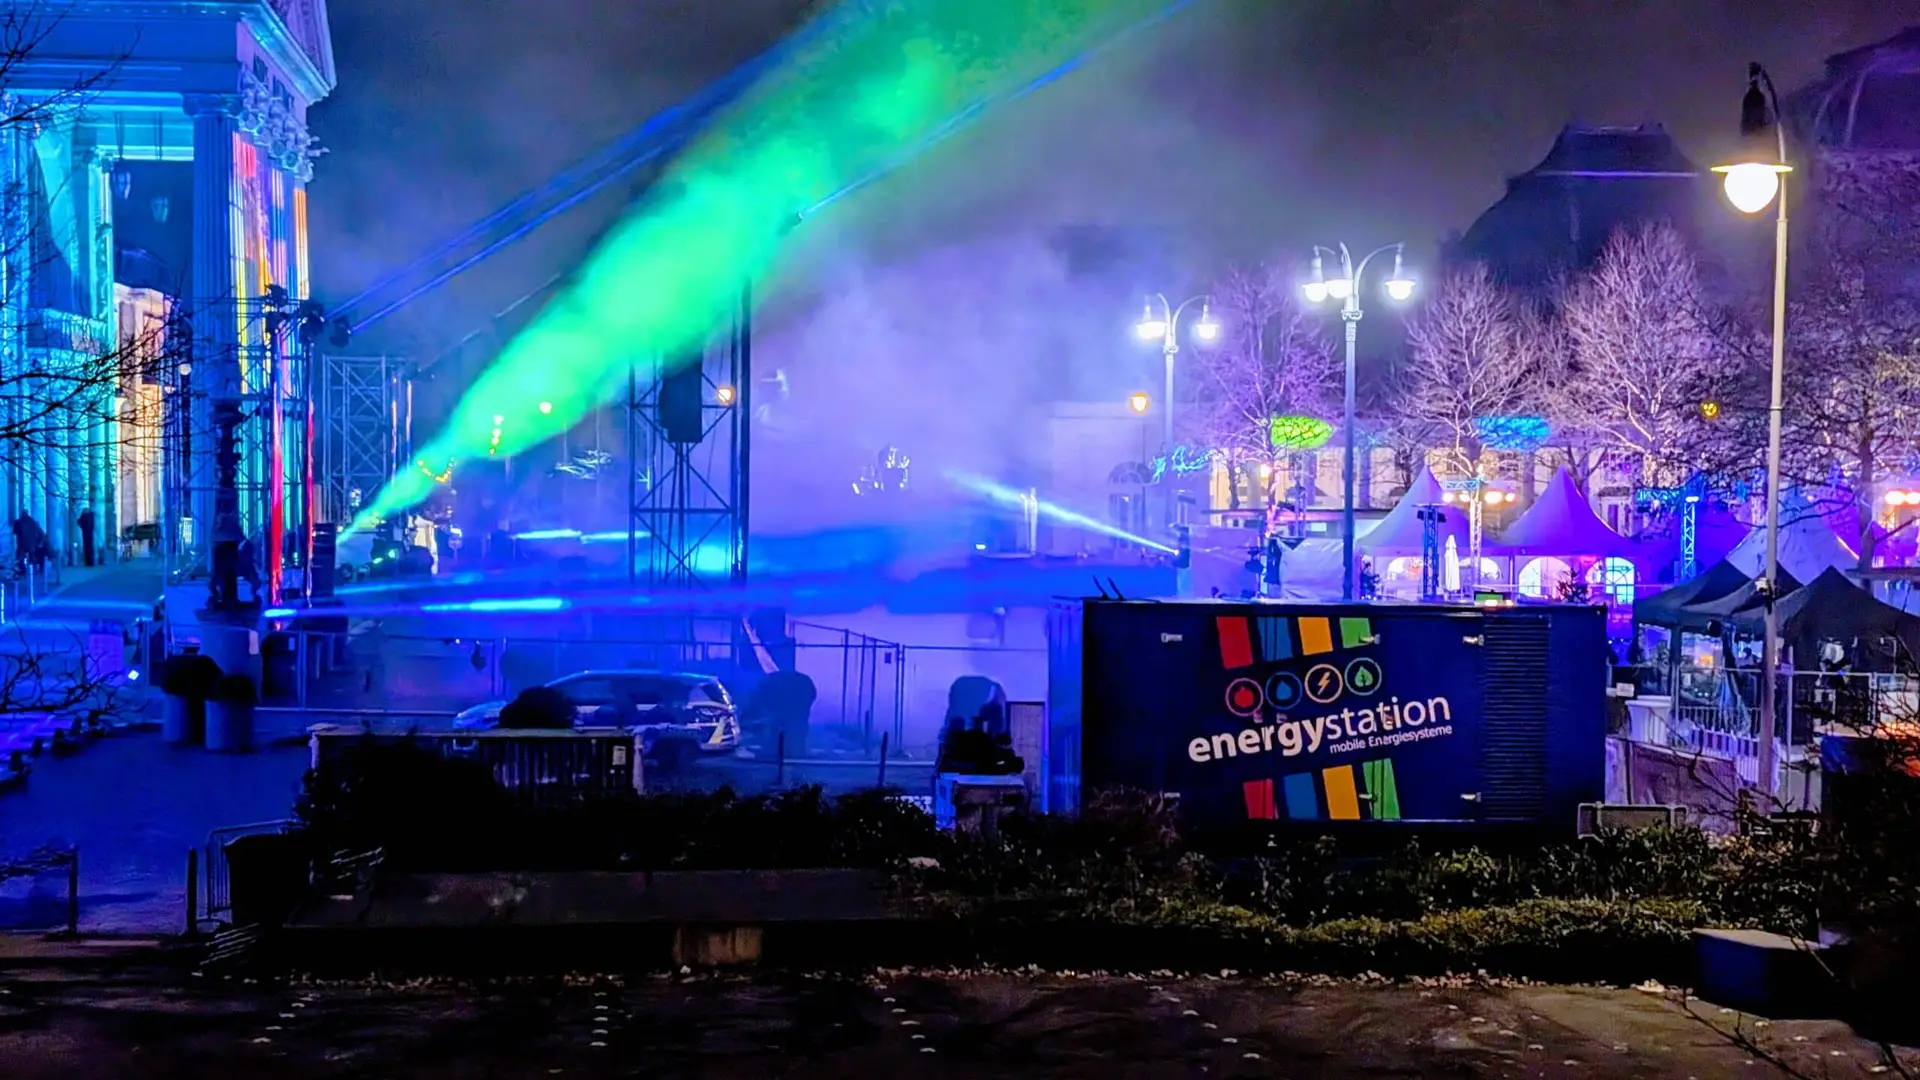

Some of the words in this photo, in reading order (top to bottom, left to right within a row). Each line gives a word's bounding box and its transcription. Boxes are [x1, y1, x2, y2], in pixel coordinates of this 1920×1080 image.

[1188, 696, 1451, 762] energystation
[1329, 739, 1366, 754] mobile
[1368, 725, 1453, 747] Energiesysteme
